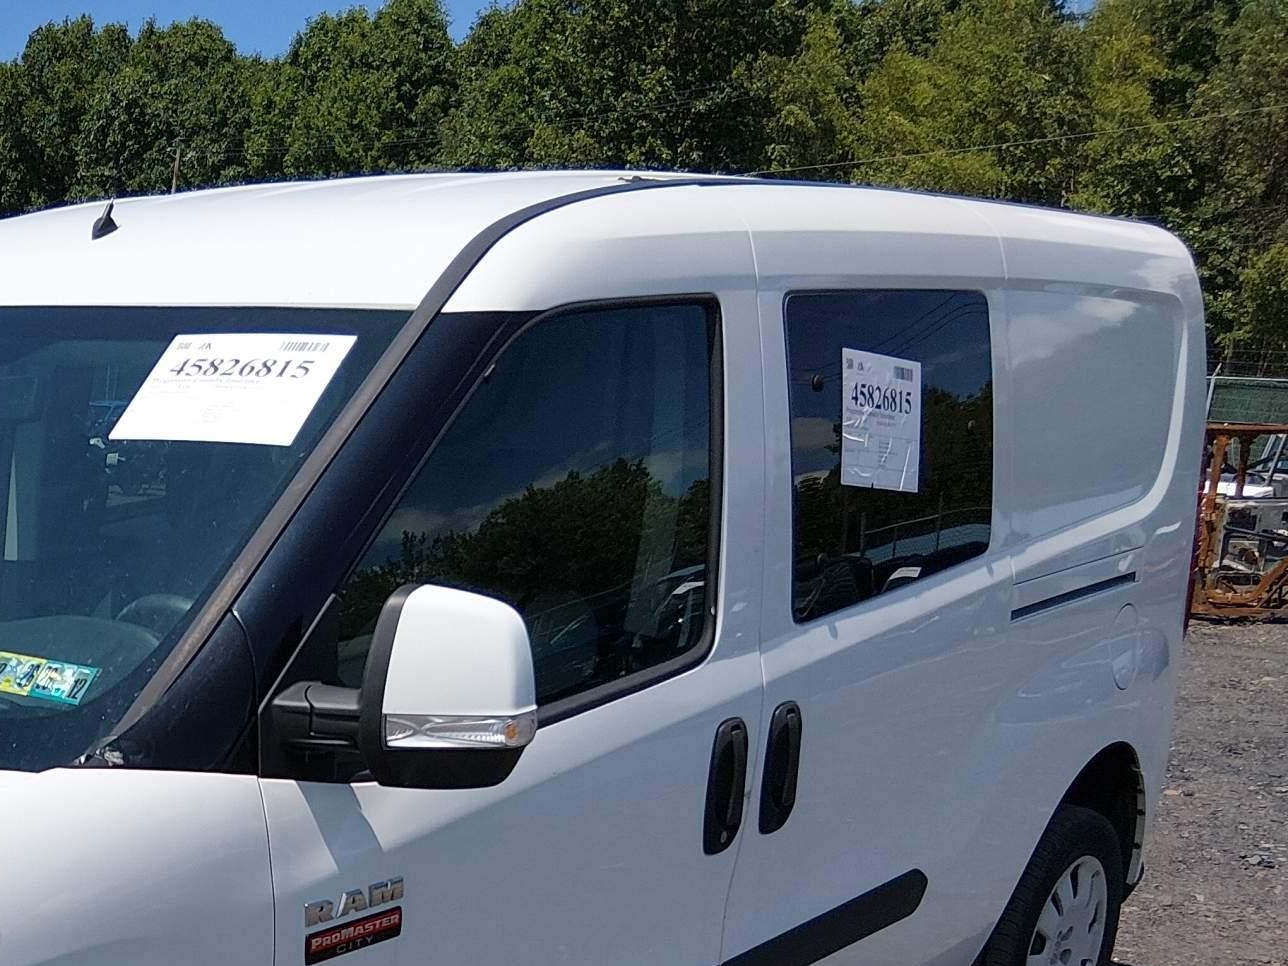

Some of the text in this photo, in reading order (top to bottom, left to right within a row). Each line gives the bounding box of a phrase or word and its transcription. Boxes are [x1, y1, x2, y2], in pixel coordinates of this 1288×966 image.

[169, 358, 315, 379] 45826815
[851, 382, 912, 415] 45826815
[304, 876, 404, 928] RAM
[336, 935, 376, 954] CITY
